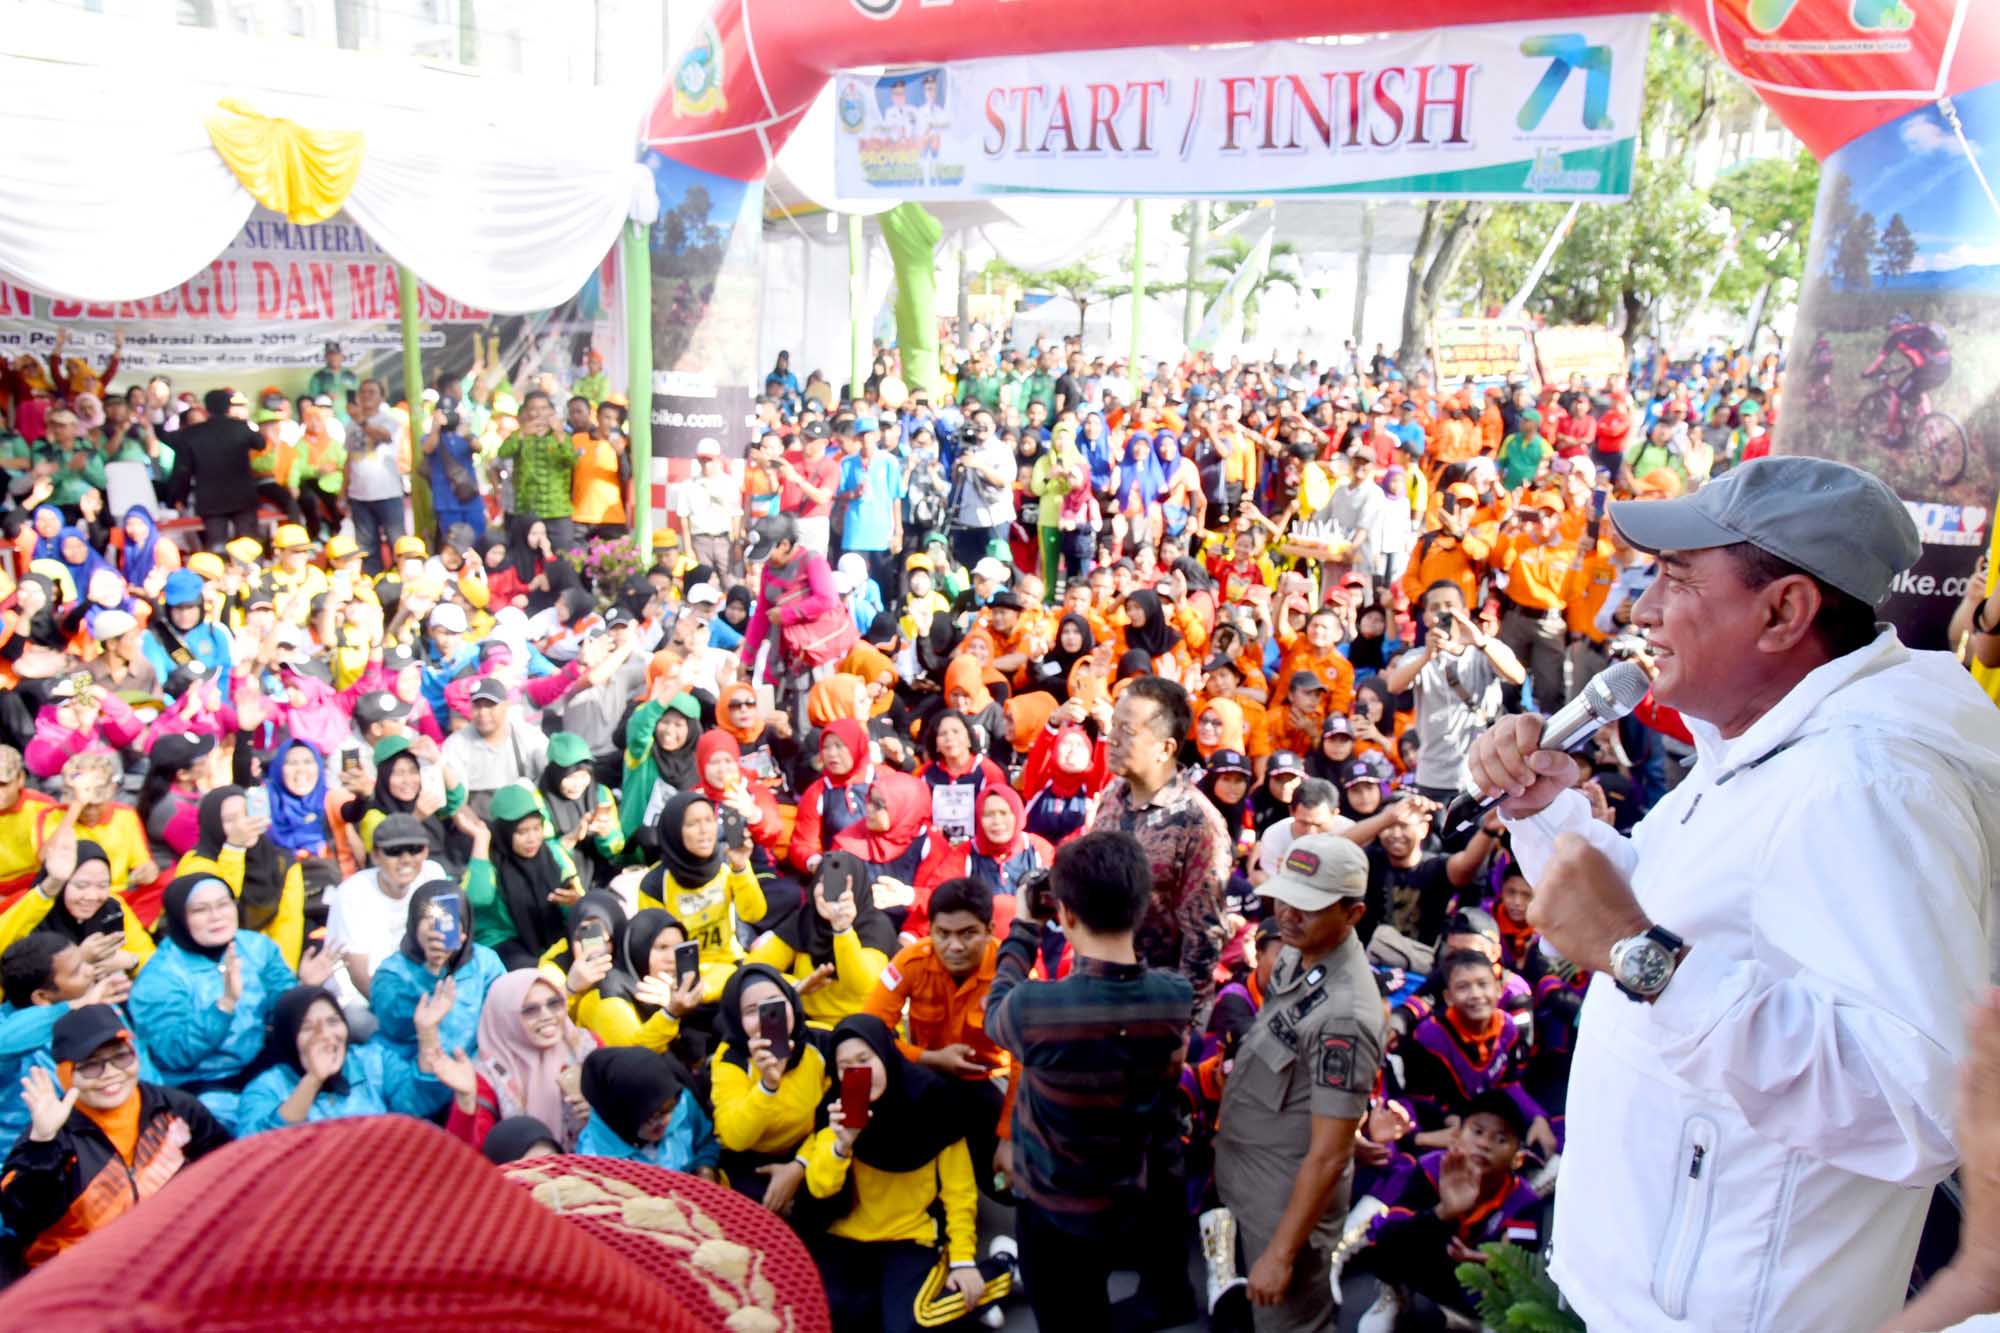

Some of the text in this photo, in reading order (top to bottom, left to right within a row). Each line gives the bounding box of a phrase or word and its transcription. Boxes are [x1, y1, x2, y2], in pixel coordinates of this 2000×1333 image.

[983, 63, 1476, 156] START / FINISH
[252, 260, 335, 320] DAN
